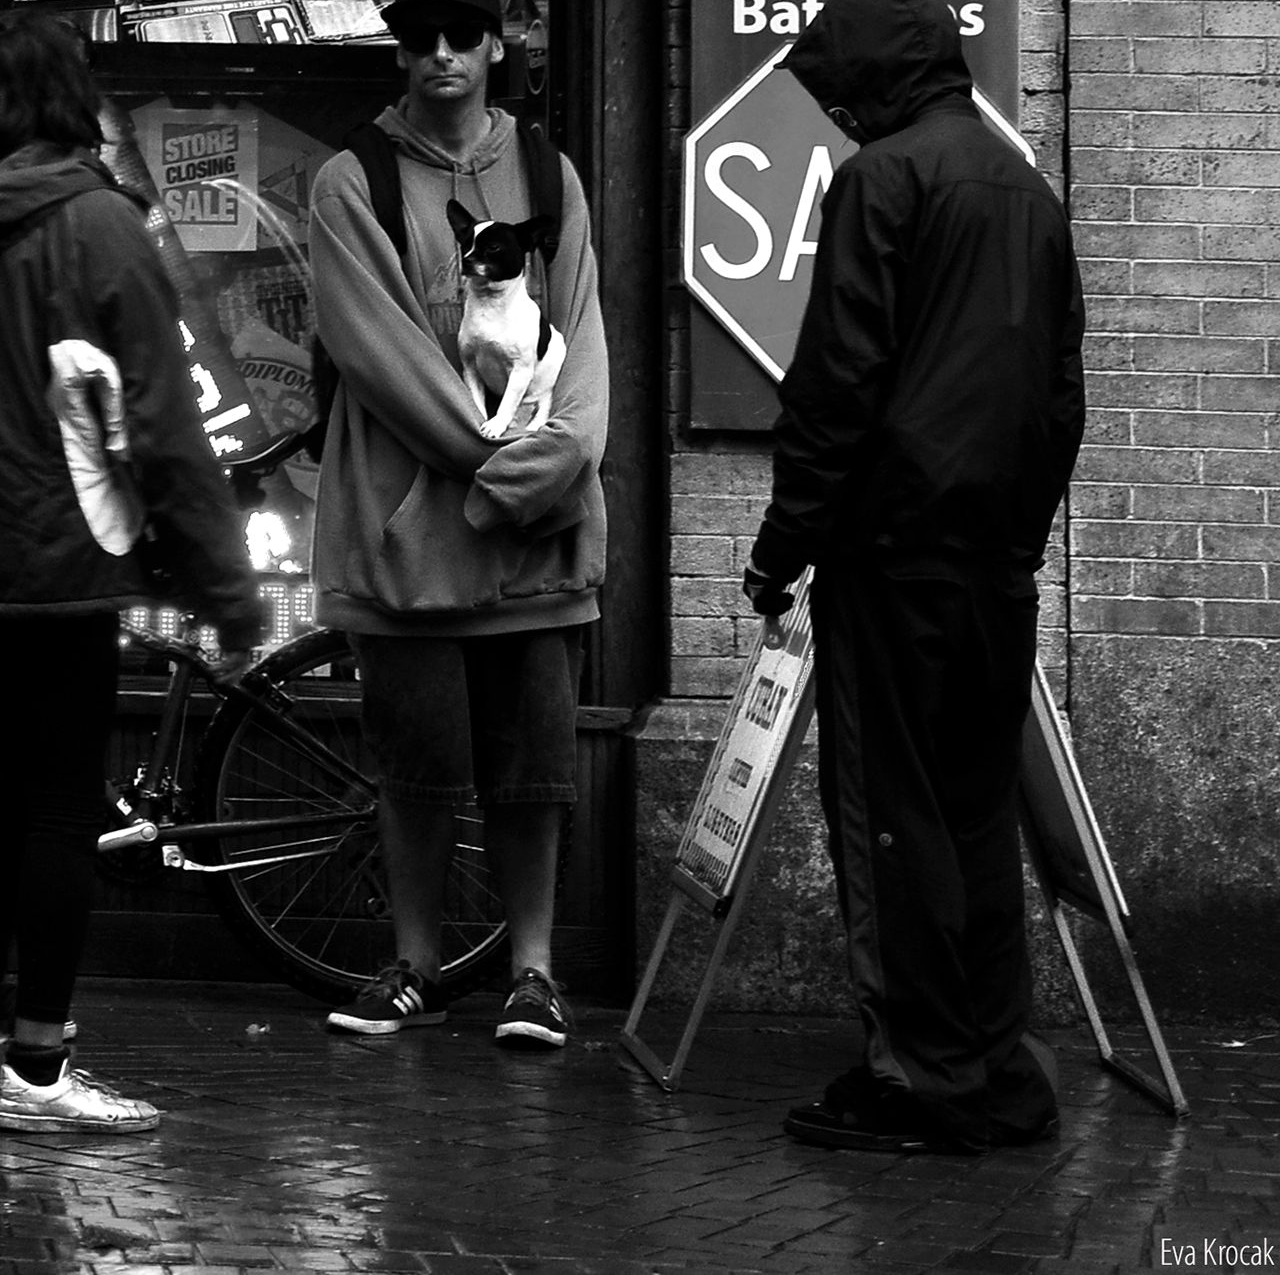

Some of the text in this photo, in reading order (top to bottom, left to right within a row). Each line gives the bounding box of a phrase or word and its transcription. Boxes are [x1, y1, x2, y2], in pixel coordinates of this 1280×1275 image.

[164, 126, 237, 162] STORE
[166, 155, 236, 184] CLOSING
[165, 188, 237, 223] SALE
[699, 141, 836, 282] SA
[243, 362, 317, 399] DIPLOM
